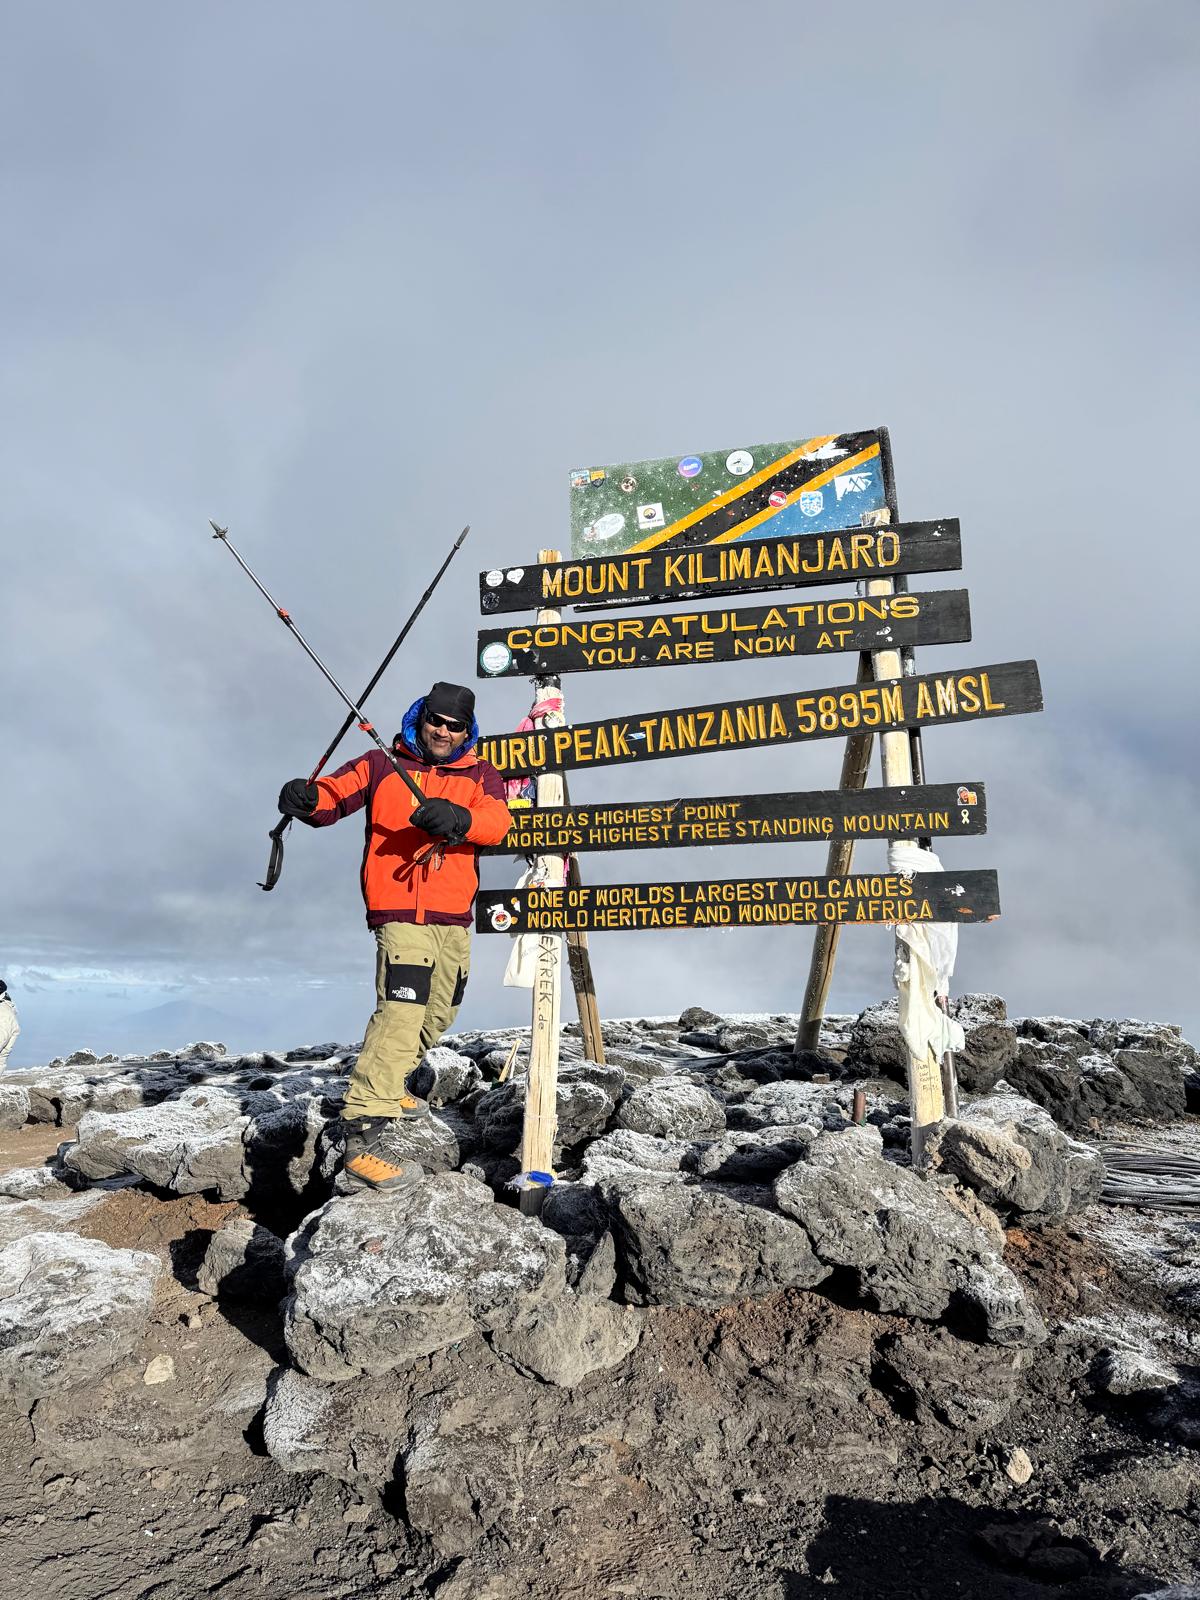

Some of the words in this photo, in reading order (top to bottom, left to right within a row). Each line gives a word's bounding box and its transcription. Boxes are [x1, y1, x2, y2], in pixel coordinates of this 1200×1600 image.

[542, 558, 651, 597] MOUNT
[665, 532, 901, 586] KILIMANJARO
[508, 597, 918, 649] CONGRATULATIONS
[582, 647, 636, 665] YOU
[656, 642, 713, 660] ARE
[735, 635, 795, 655] NOW
[817, 630, 852, 648] AT
[796, 685, 905, 733] 5895M
[917, 673, 1005, 718] AMSL
[507, 830, 582, 847] WORLD'S
[590, 825, 672, 843] HIGHEST
[679, 822, 730, 839] FREE
[736, 817, 833, 836] STANDING
[844, 812, 949, 832] MOUNTAIN
[595, 807, 674, 825] HIGHEST
[685, 803, 740, 820] POINT
[528, 891, 563, 908] ONE
[569, 890, 590, 906] OF
[597, 886, 674, 905] WORLD'S
[681, 884, 778, 903] LARGEST
[786, 877, 913, 899] VOLCANOES
[528, 910, 588, 928] WORLD
[594, 907, 687, 926] HERITAGE
[694, 905, 731, 923] AND
[739, 902, 817, 922] WONDER
[824, 901, 851, 920] OF
[855, 900, 933, 920] AFRICA
